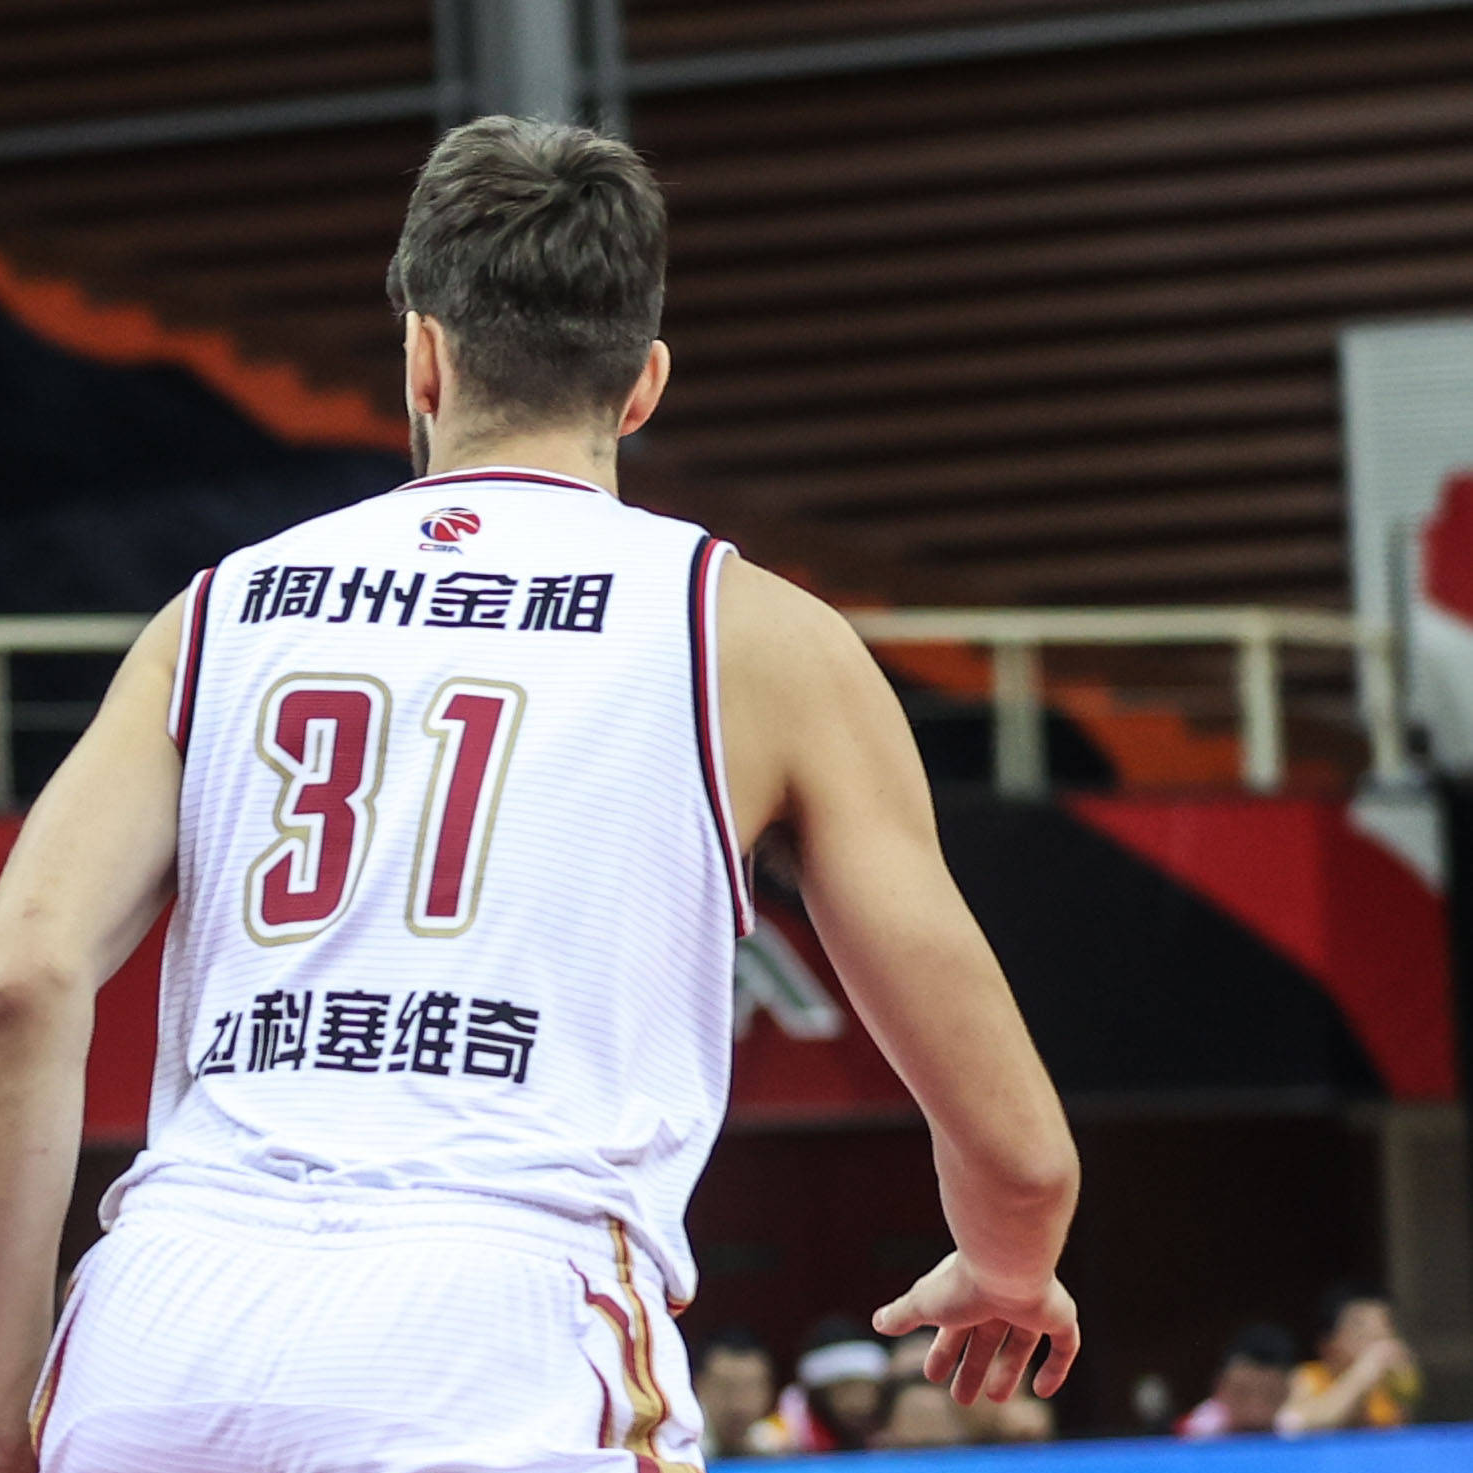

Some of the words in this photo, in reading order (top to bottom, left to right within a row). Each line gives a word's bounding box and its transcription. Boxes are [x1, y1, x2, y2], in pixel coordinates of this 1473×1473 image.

[239, 564, 615, 634] 稠州金租
[246, 673, 526, 946] 31
